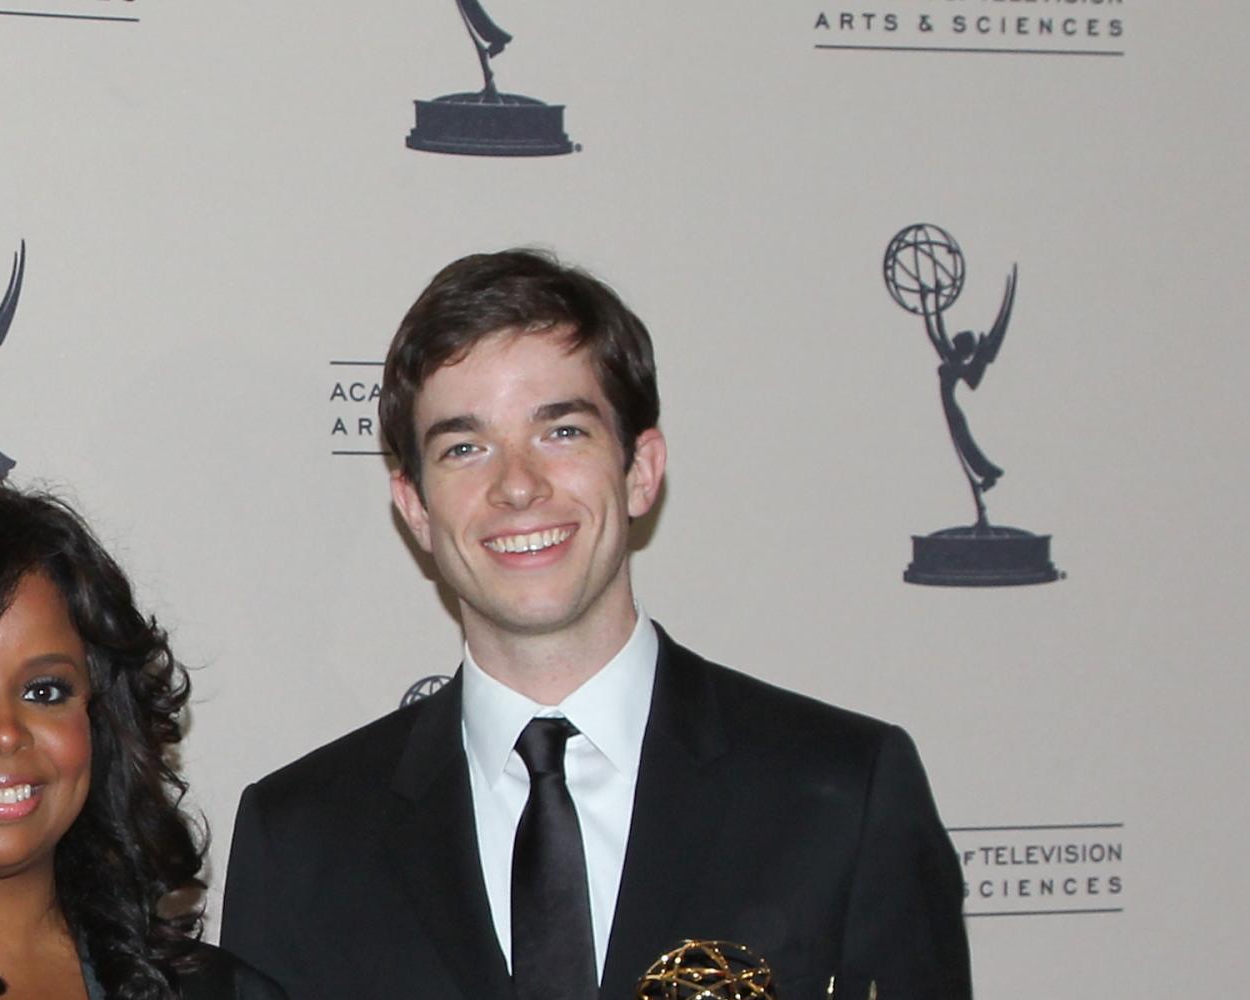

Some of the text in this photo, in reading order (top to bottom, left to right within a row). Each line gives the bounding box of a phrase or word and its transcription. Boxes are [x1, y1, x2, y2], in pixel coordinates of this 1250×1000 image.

[814, 12, 1124, 37] ARTS & SCIENCES
[958, 843, 1123, 866] F TELEVISION
